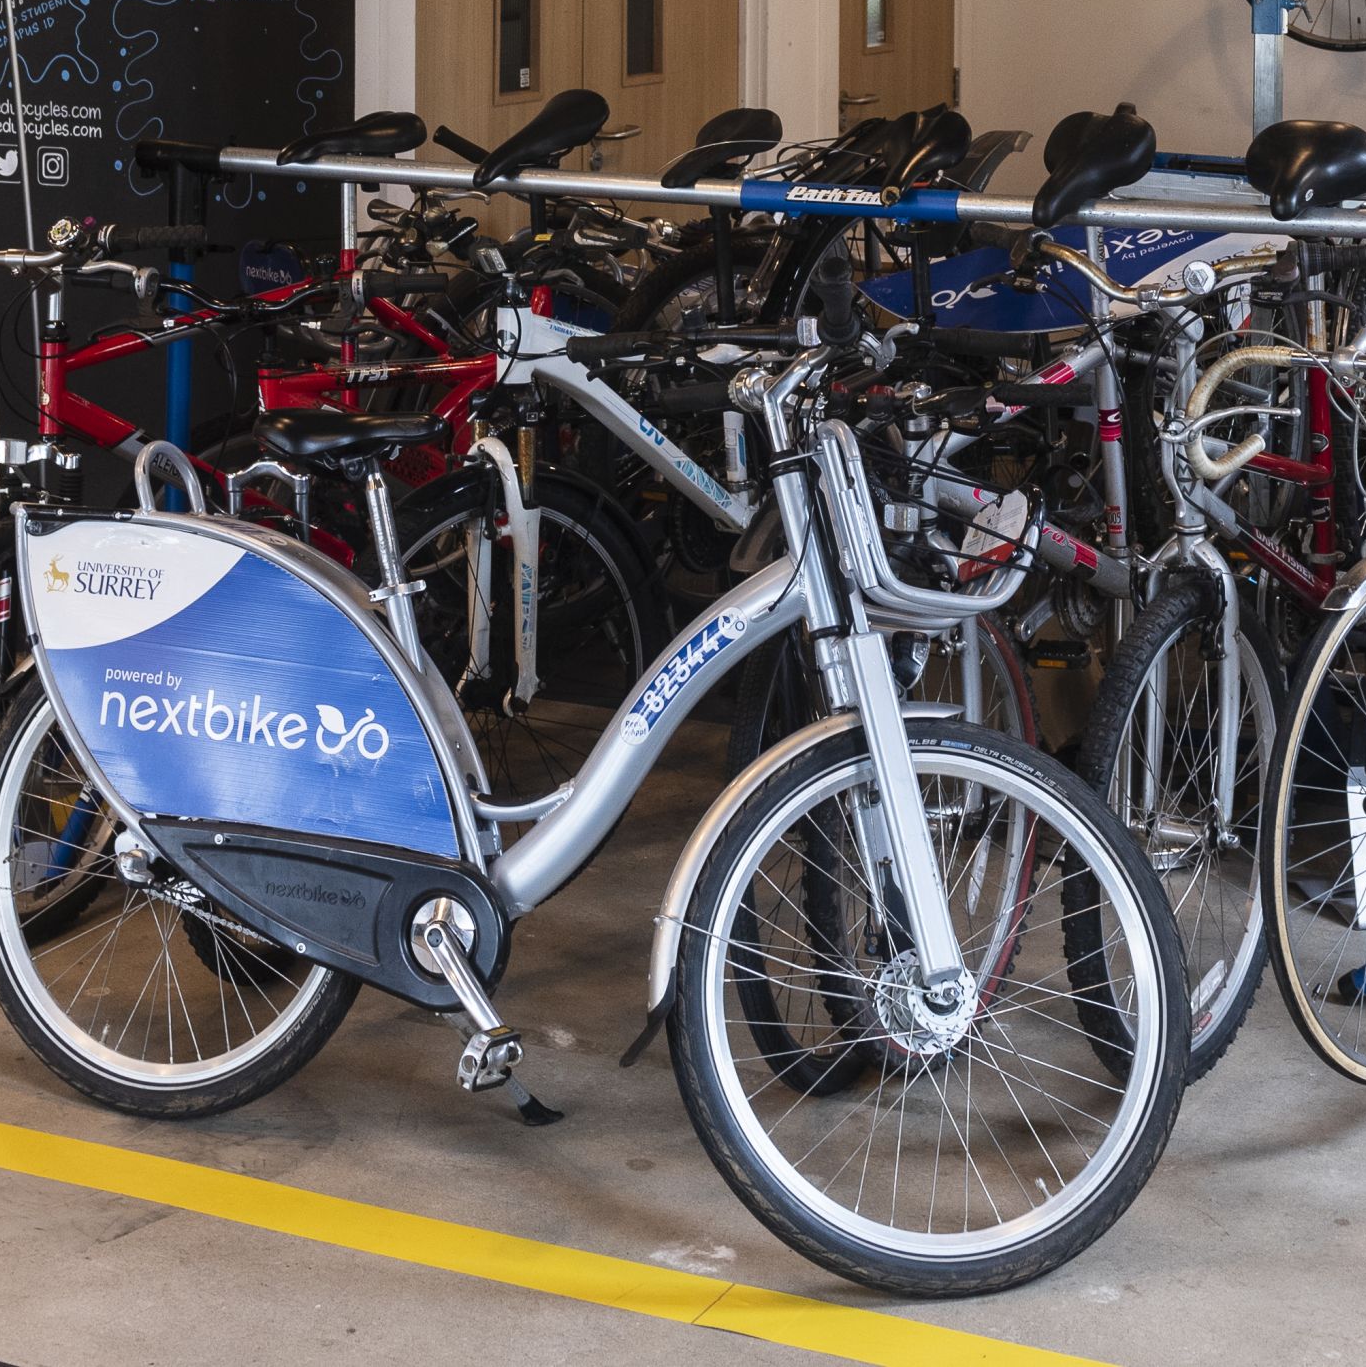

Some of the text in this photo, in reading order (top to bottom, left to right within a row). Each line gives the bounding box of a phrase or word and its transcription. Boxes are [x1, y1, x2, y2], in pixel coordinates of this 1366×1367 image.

[43, 17, 55, 29] ID
[1139, 233, 1195, 256] powered
[245, 265, 279, 284] nextbike
[77, 560, 165, 579] UNIVERSITY OF
[74, 572, 161, 600] SURREY
[105, 668, 182, 691] powered by
[643, 629, 720, 713] 82344
[99, 689, 308, 750] nextbike
[972, 745, 1000, 759] DELTA
[999, 753, 1035, 774] CRUISER
[266, 880, 339, 906] nextbike
